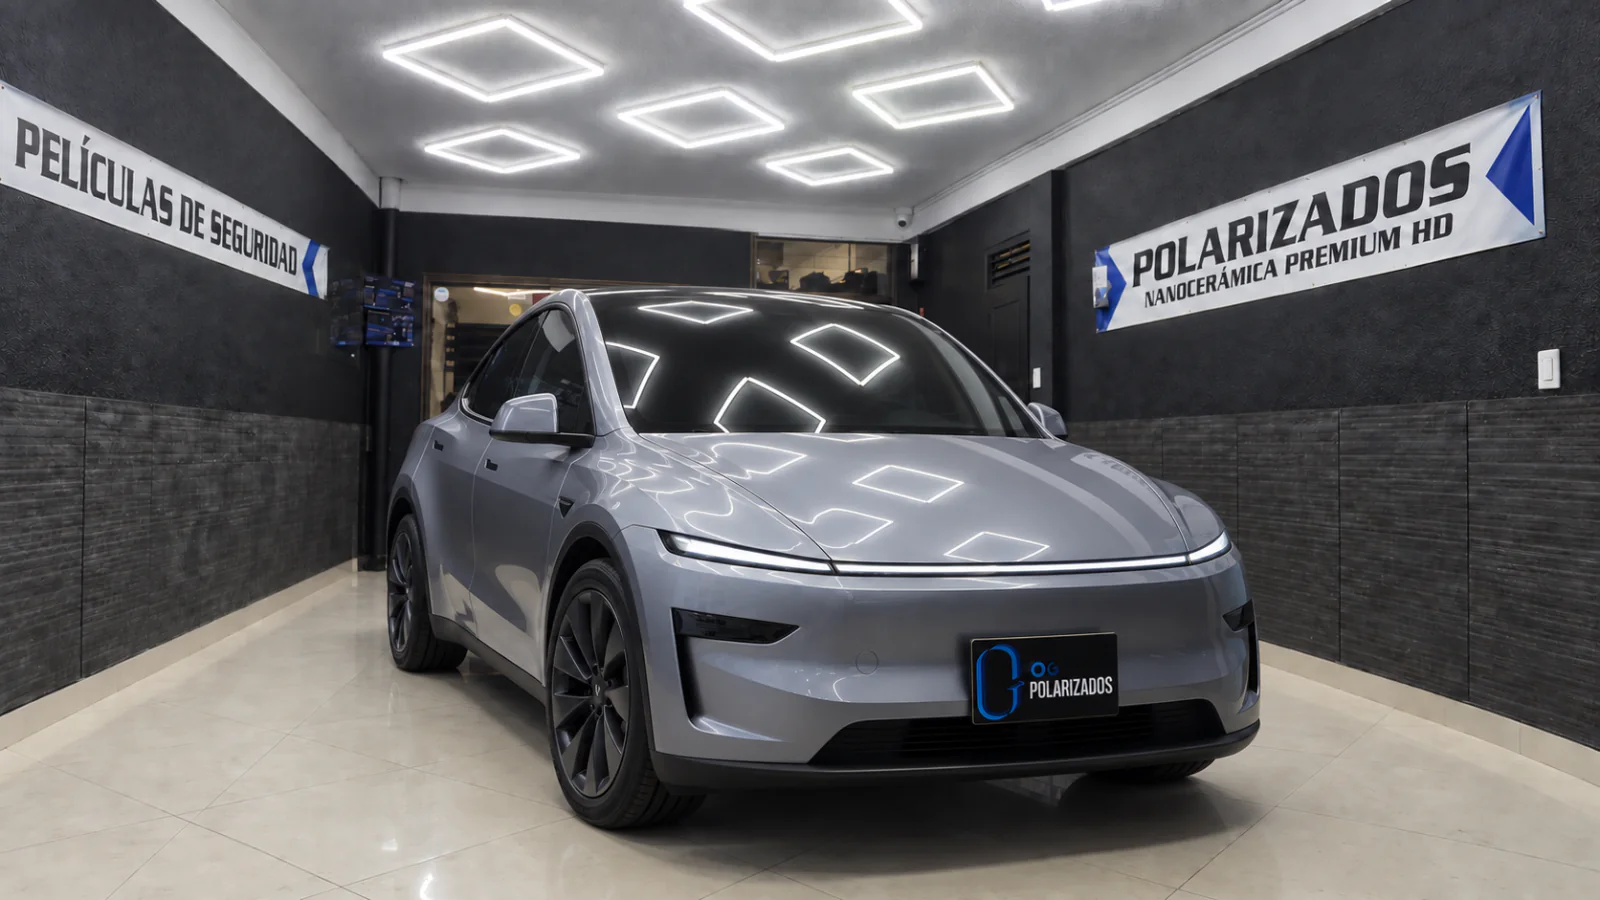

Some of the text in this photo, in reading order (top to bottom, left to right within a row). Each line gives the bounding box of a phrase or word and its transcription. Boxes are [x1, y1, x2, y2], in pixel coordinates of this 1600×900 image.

[15, 117, 297, 276] PELÍCULAS DE SEGURIDAD
[1132, 142, 1472, 287] POLARIZADOS
[1144, 212, 1454, 308] NANOCERÁMICA PREMIUM HD
[1029, 676, 1113, 699] POLARIZADOS
[1030, 661, 1060, 678] OG
